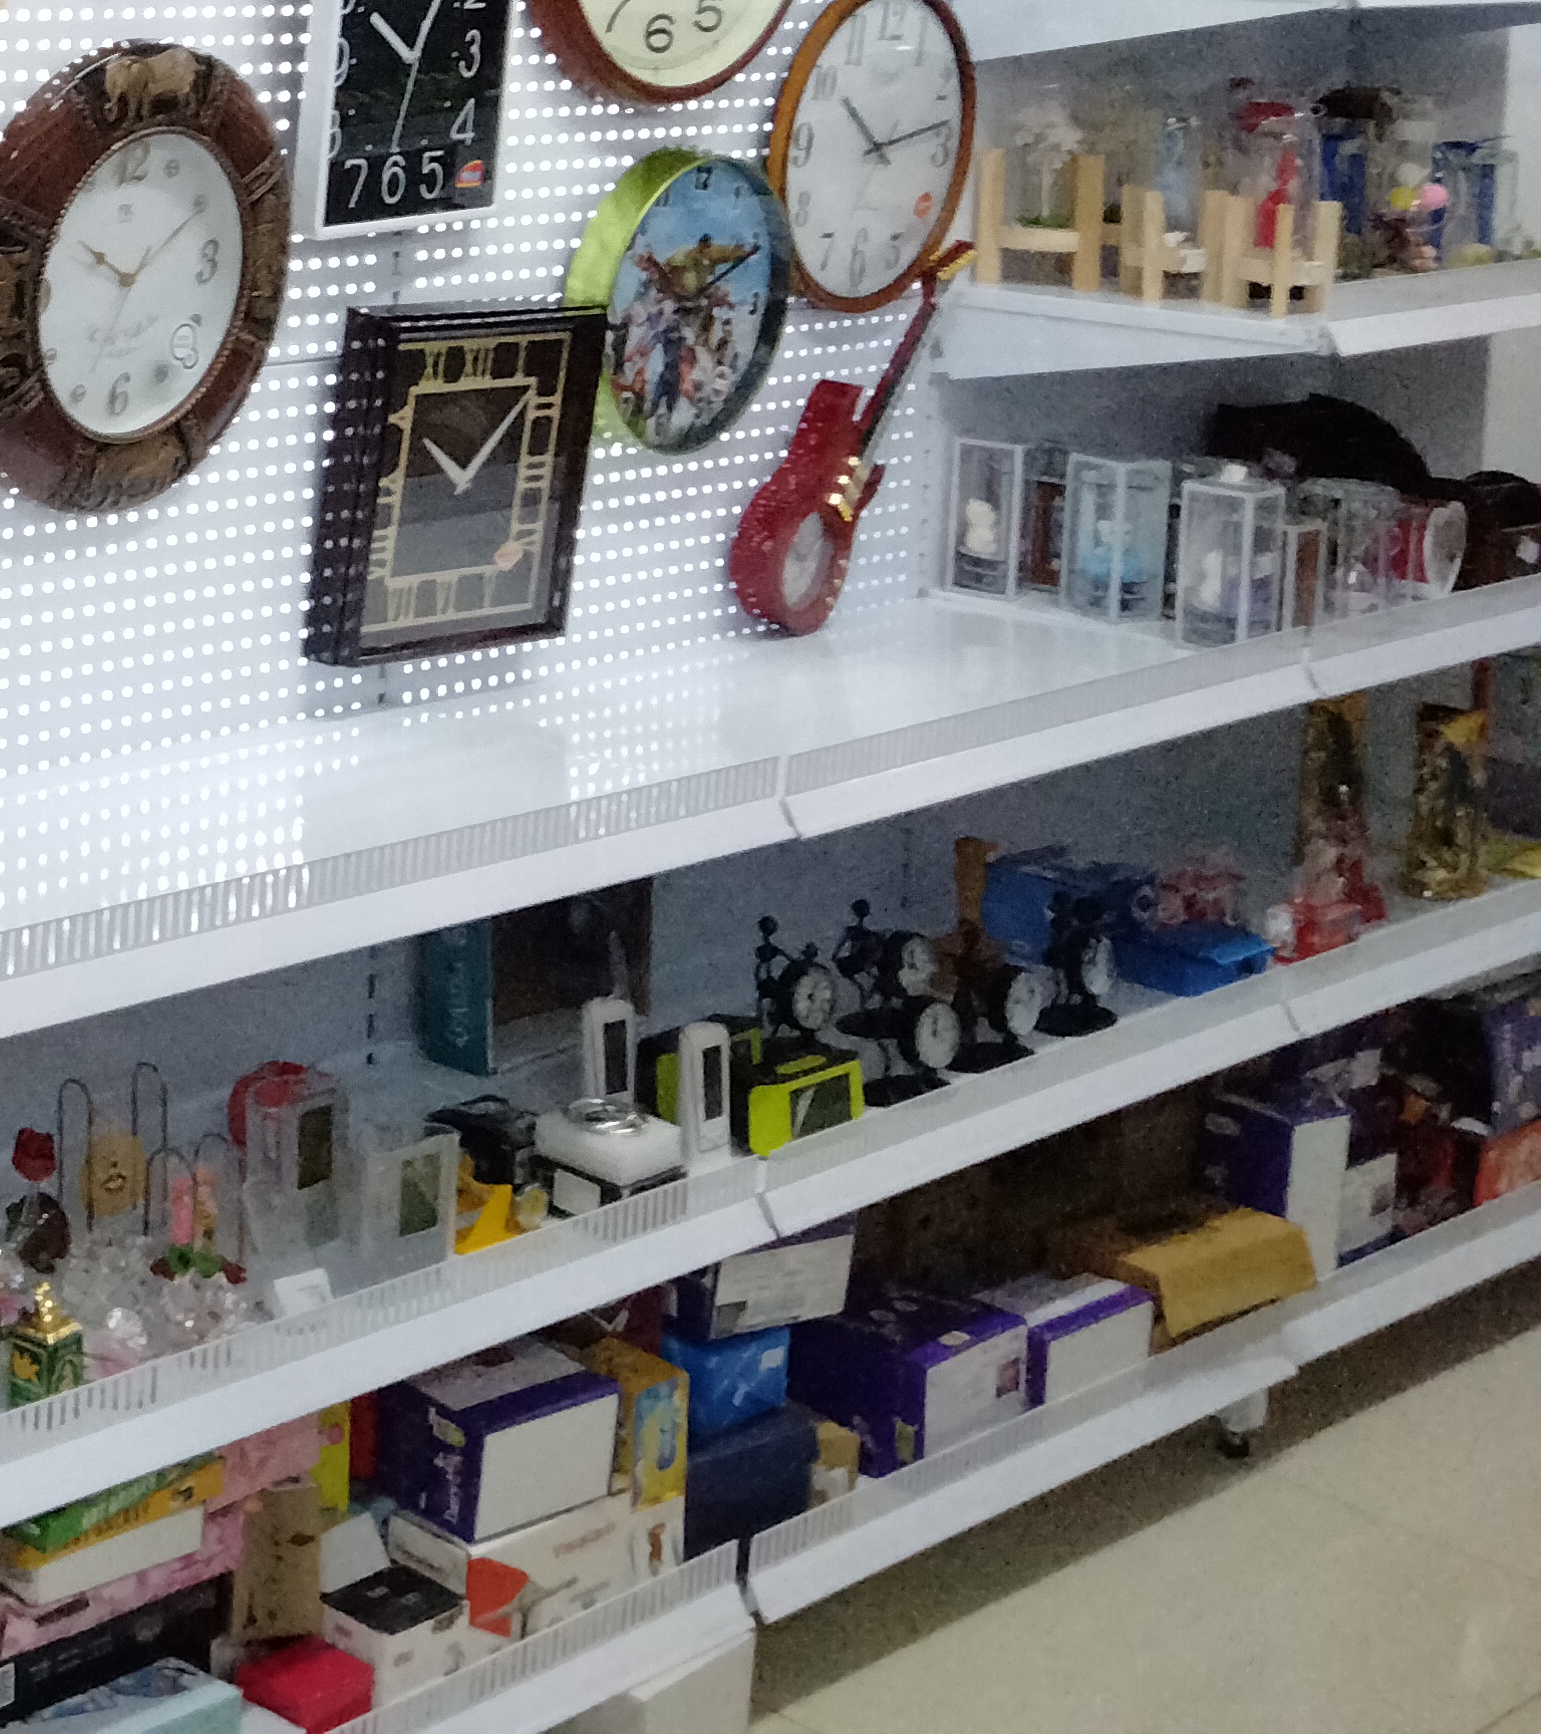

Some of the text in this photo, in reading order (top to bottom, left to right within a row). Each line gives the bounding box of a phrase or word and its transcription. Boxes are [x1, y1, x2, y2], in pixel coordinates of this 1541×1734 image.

[644, 14, 674, 53] 6
[845, 14, 866, 65] 11
[877, 0, 908, 40] 12
[458, 29, 481, 77] 3
[811, 65, 837, 101] 10
[450, 98, 475, 145] 4
[791, 123, 814, 168] 9
[930, 124, 953, 167] 3
[344, 159, 368, 208] 7
[381, 155, 406, 204] 6
[419, 150, 445, 199] 5
[795, 190, 811, 227] 8
[195, 239, 219, 286] 3
[820, 232, 835, 271] 7
[849, 228, 867, 293] 6
[889, 232, 904, 269] 5
[107, 372, 131, 416] 6
